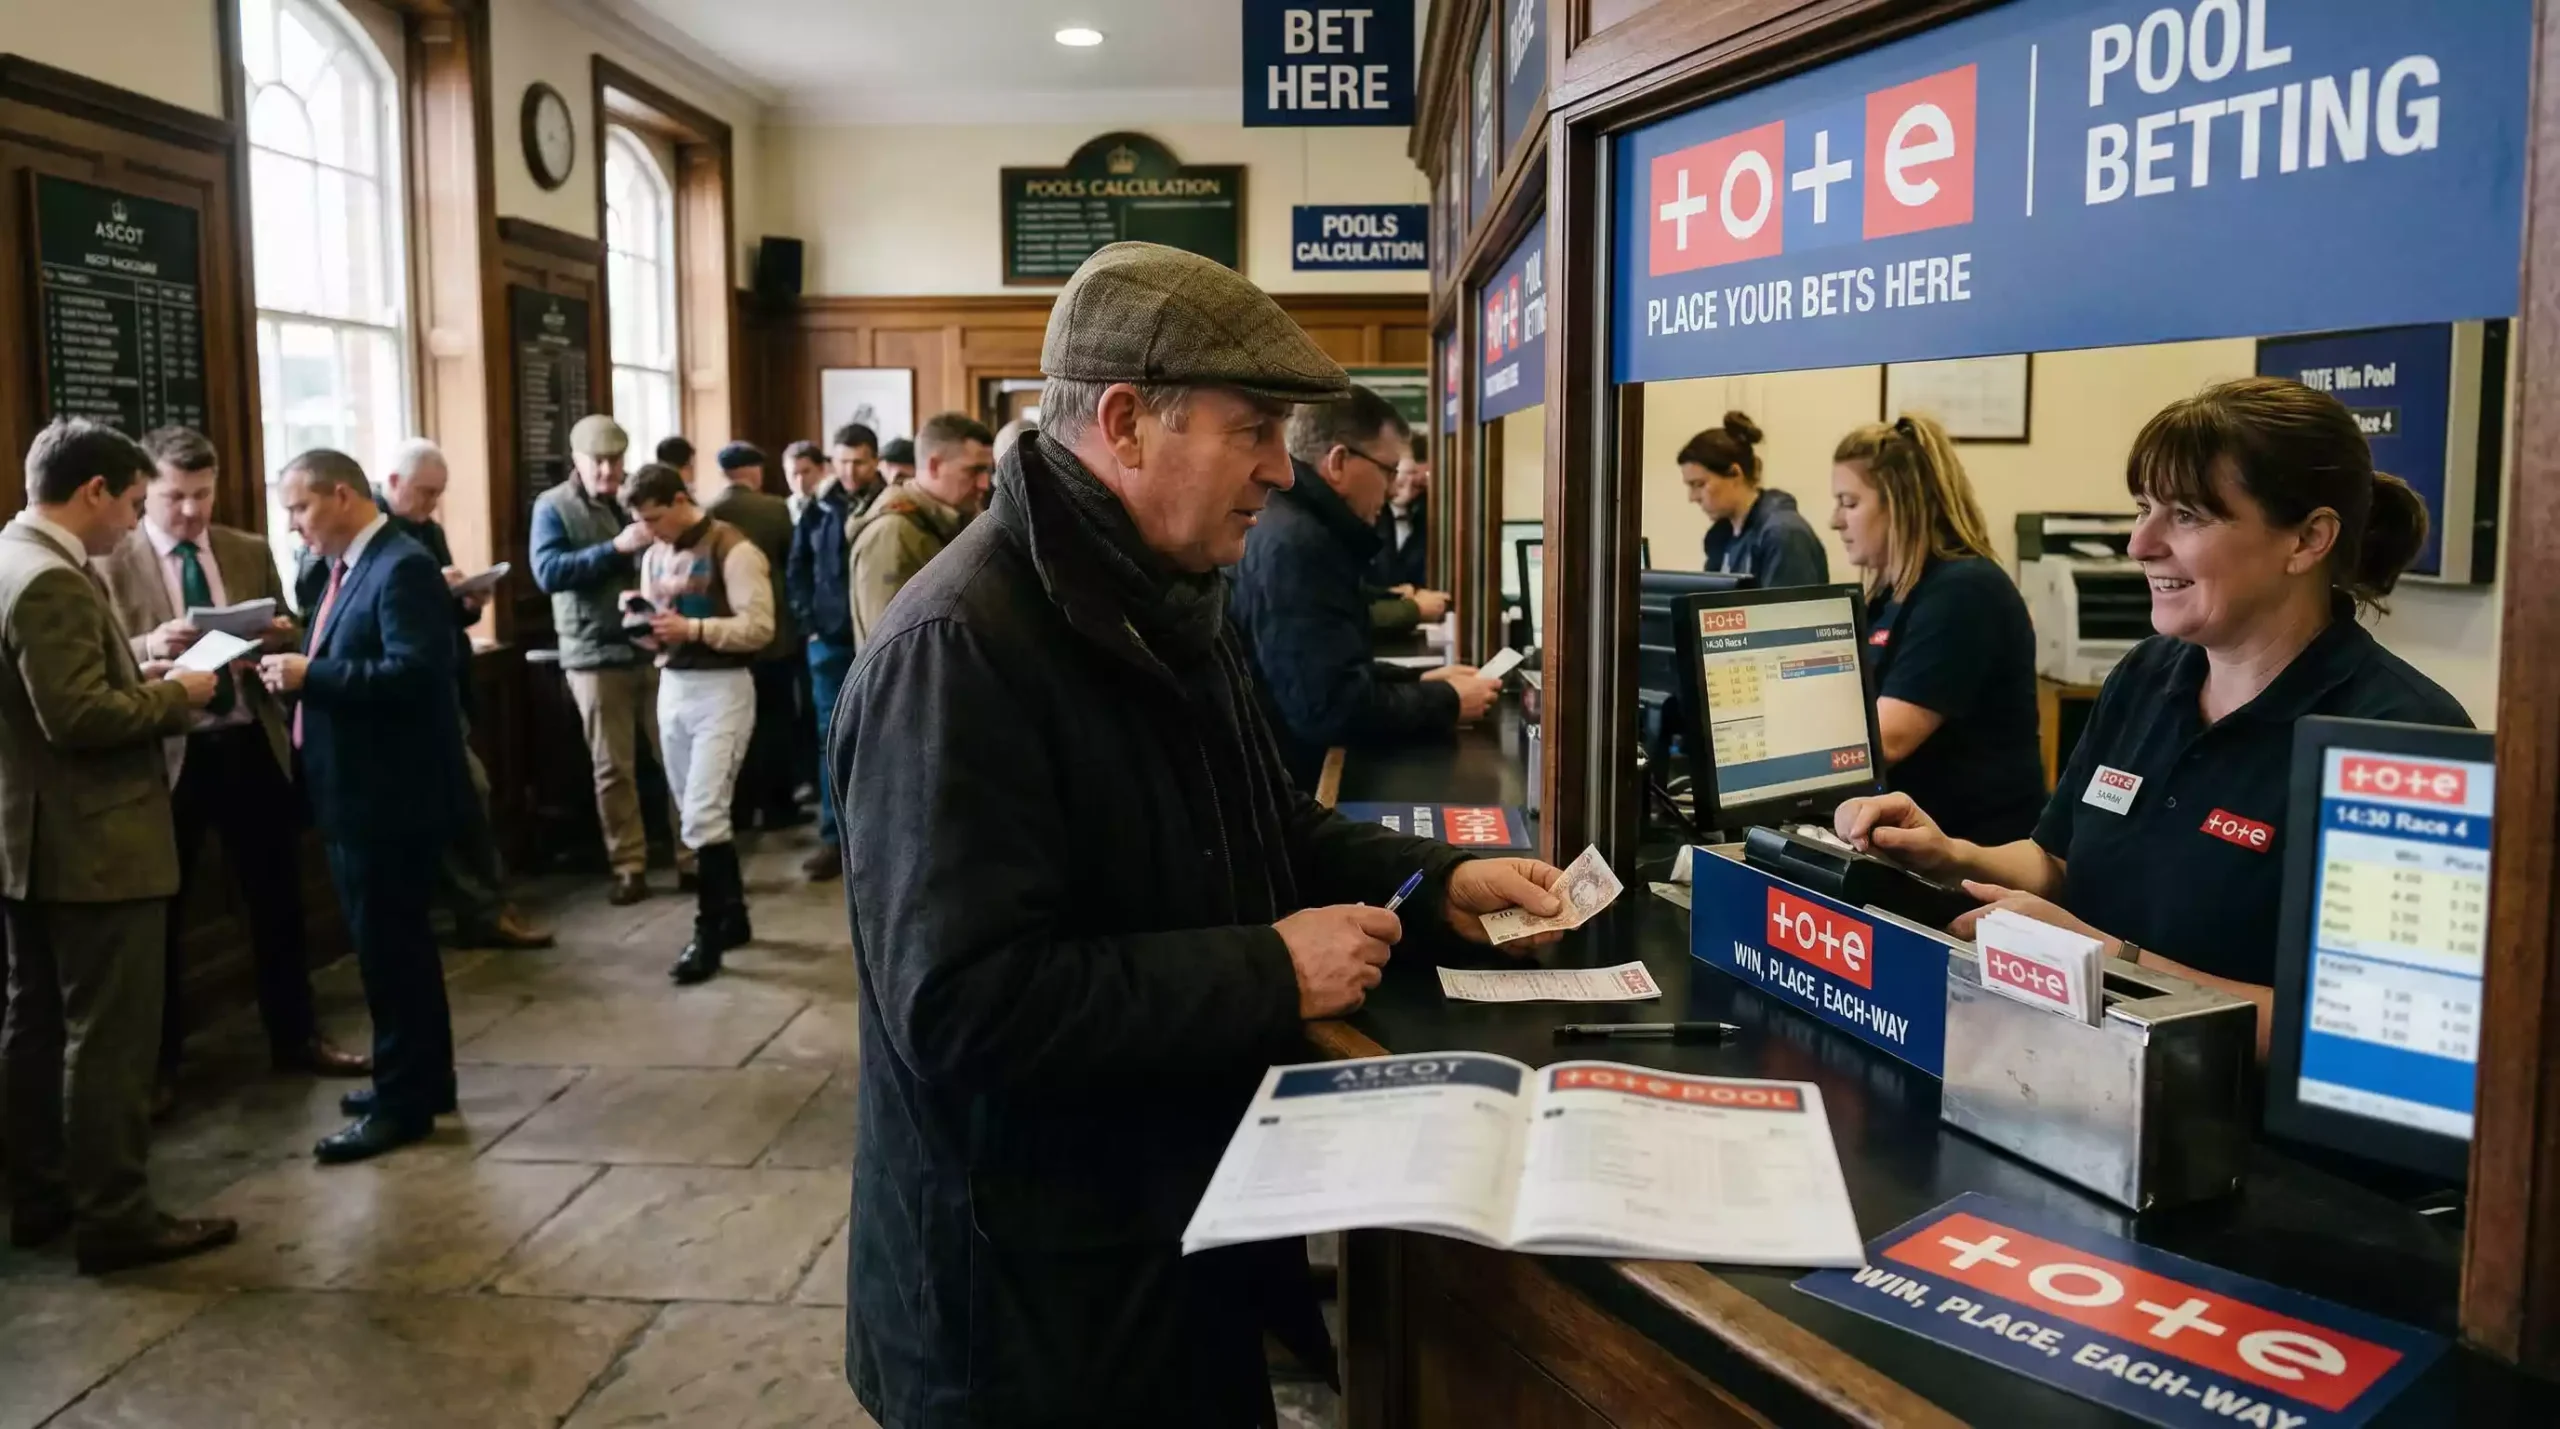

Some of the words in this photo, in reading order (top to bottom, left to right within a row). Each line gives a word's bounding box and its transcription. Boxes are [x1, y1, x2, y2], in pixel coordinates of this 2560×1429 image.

[1284, 9, 1373, 54] BET
[2089, 0, 2292, 107] POOL
[1268, 65, 1389, 109] HERE
[2085, 54, 2440, 206] BETTING
[1026, 180, 1086, 197] POOLS
[1090, 179, 1220, 197] CALCULATION
[95, 221, 144, 244] ASCOT
[1322, 215, 1398, 238] POOLS
[1296, 242, 1424, 262] CALCULATION
[1648, 291, 1717, 336] PLACE
[1725, 280, 1792, 327] YOUR
[1802, 267, 1876, 318] BETS
[1885, 253, 1971, 308] HERE
[2301, 368, 2332, 392] TOTE
[2335, 365, 2361, 390] Win
[2364, 362, 2396, 388] Pool
[2381, 411, 2393, 432] 4
[2336, 805, 2390, 829] 14:30
[2395, 811, 2449, 837] Race
[2453, 819, 2468, 840] 4
[1734, 940, 1765, 982] WIN,
[1770, 958, 1819, 1008] PLACE,
[1823, 982, 1909, 1045] EACH-WAY
[1332, 1060, 1464, 1083] ASCOT
[1681, 1083, 1795, 1108] POOL
[1852, 1264, 1931, 1309] WIN,
[1936, 1295, 2065, 1358] PLACE,
[2072, 1342, 2307, 1429] EACH-WAY
